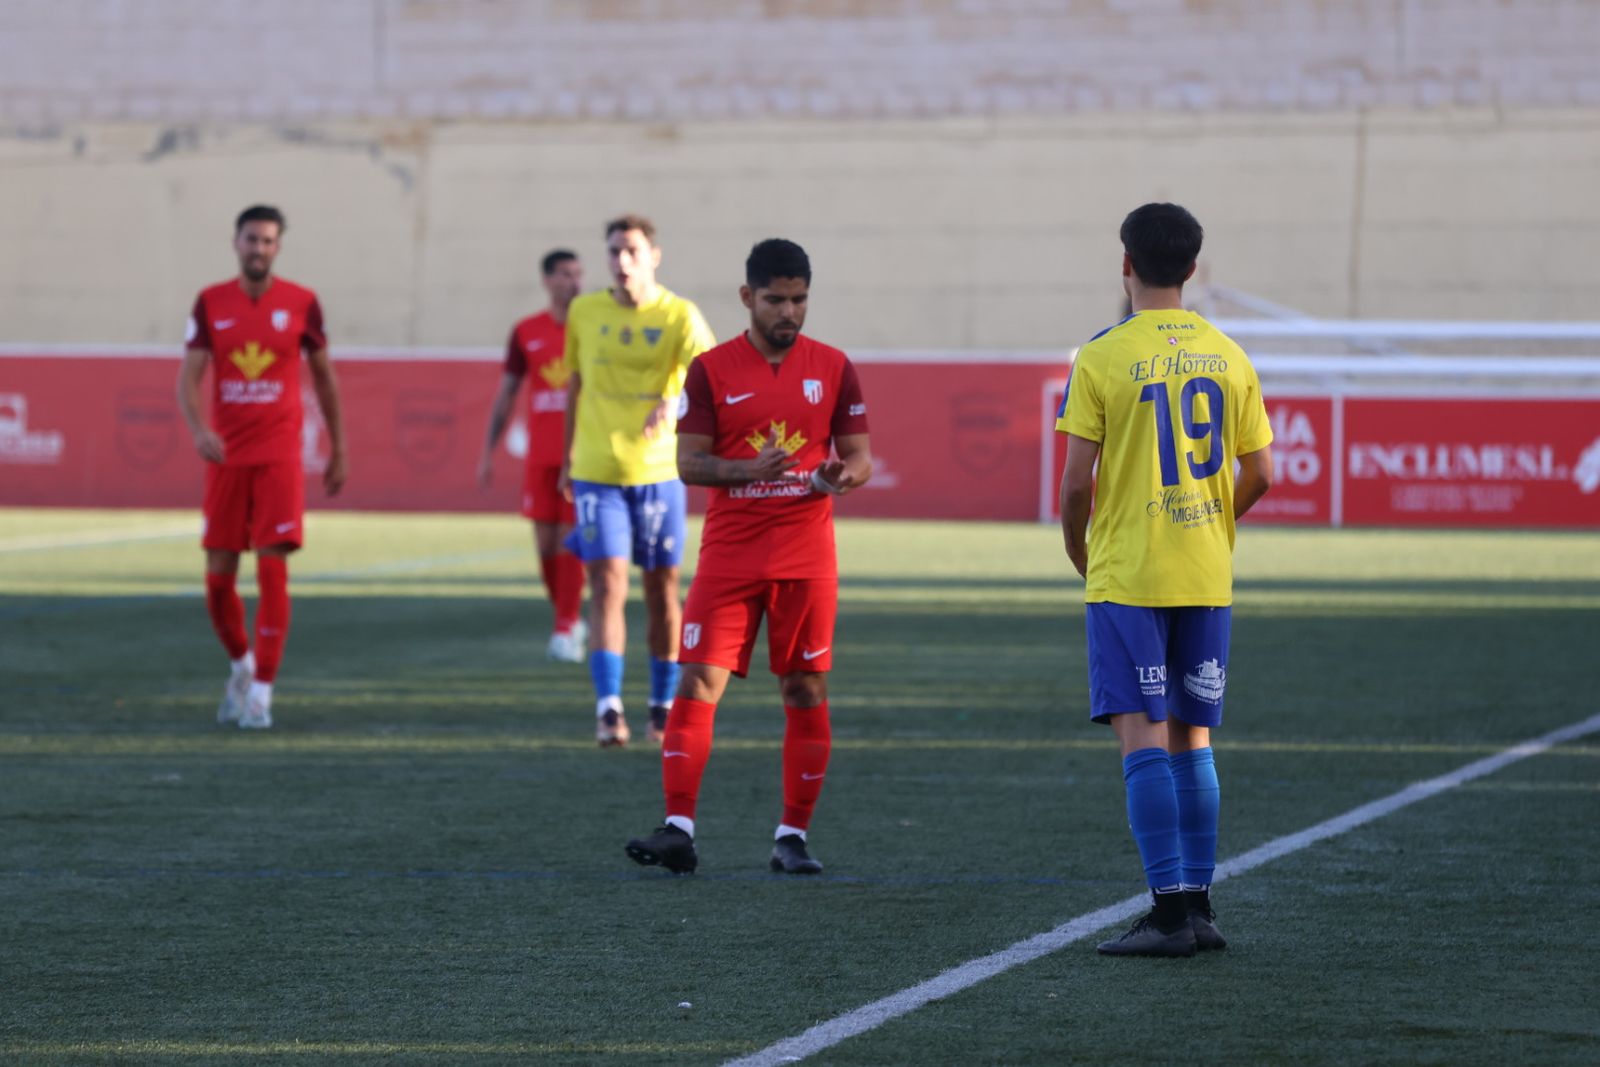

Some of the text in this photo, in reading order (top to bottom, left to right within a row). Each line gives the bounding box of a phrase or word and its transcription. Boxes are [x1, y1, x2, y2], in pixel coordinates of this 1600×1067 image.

[1157, 323, 1196, 331] KELME
[1183, 351, 1222, 361] Restaurante
[1129, 354, 1160, 382] El
[1139, 376, 1225, 487] 19
[1271, 450, 1322, 485] TO
[745, 484, 811, 498] SALAMANC
